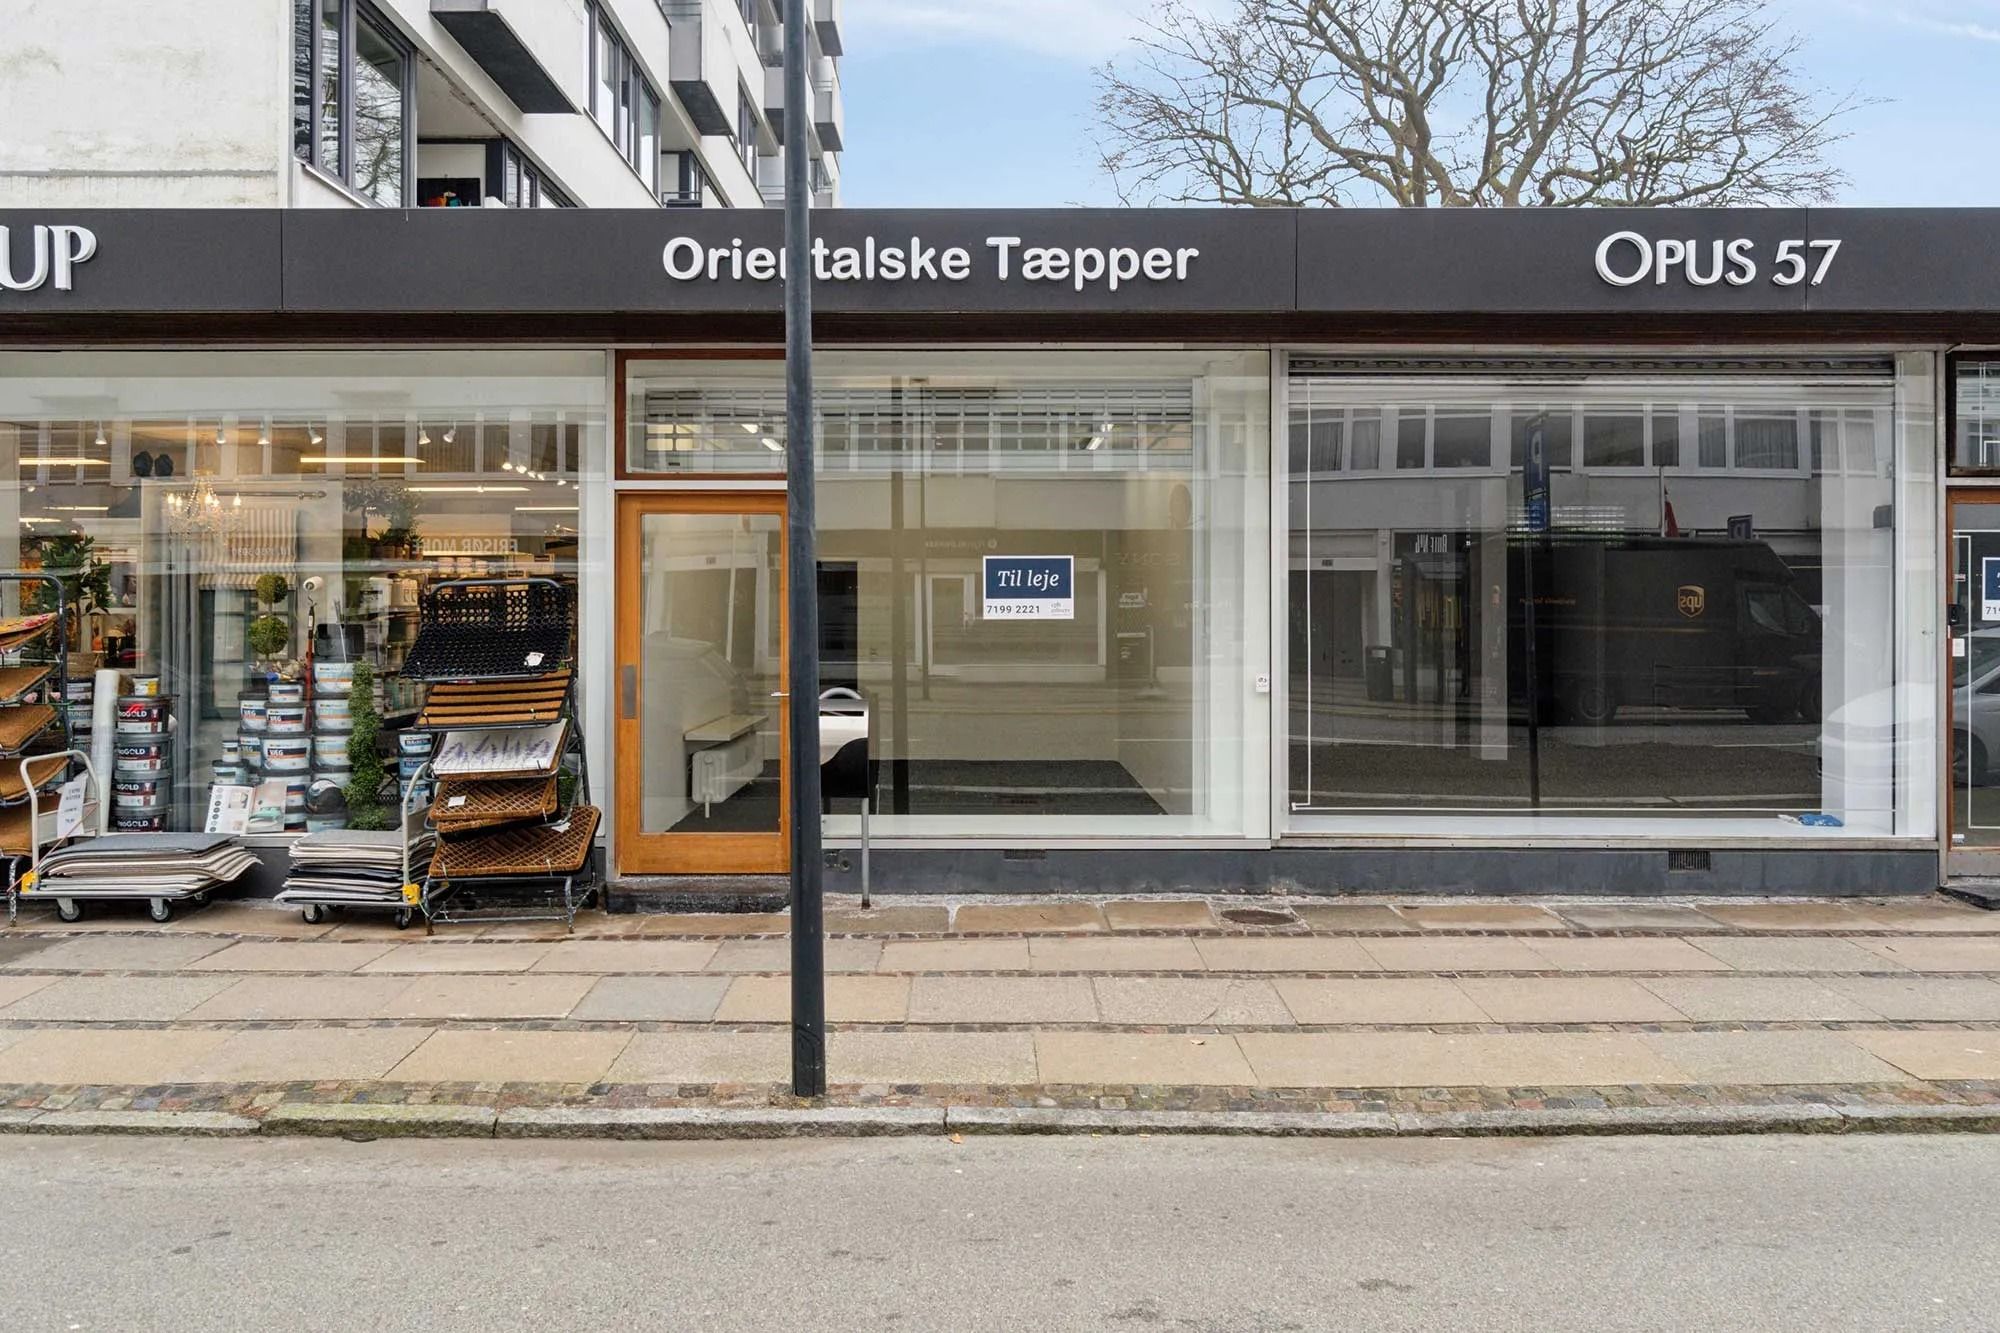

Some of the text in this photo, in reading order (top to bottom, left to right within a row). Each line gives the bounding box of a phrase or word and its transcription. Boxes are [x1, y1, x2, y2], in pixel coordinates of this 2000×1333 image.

[0, 225, 97, 291] UP
[662, 235, 1200, 292] Orietalske Tæpper
[1772, 239, 1842, 286] 57
[997, 569, 1060, 592] Til leje
[986, 605, 1040, 614] 7199 2221
